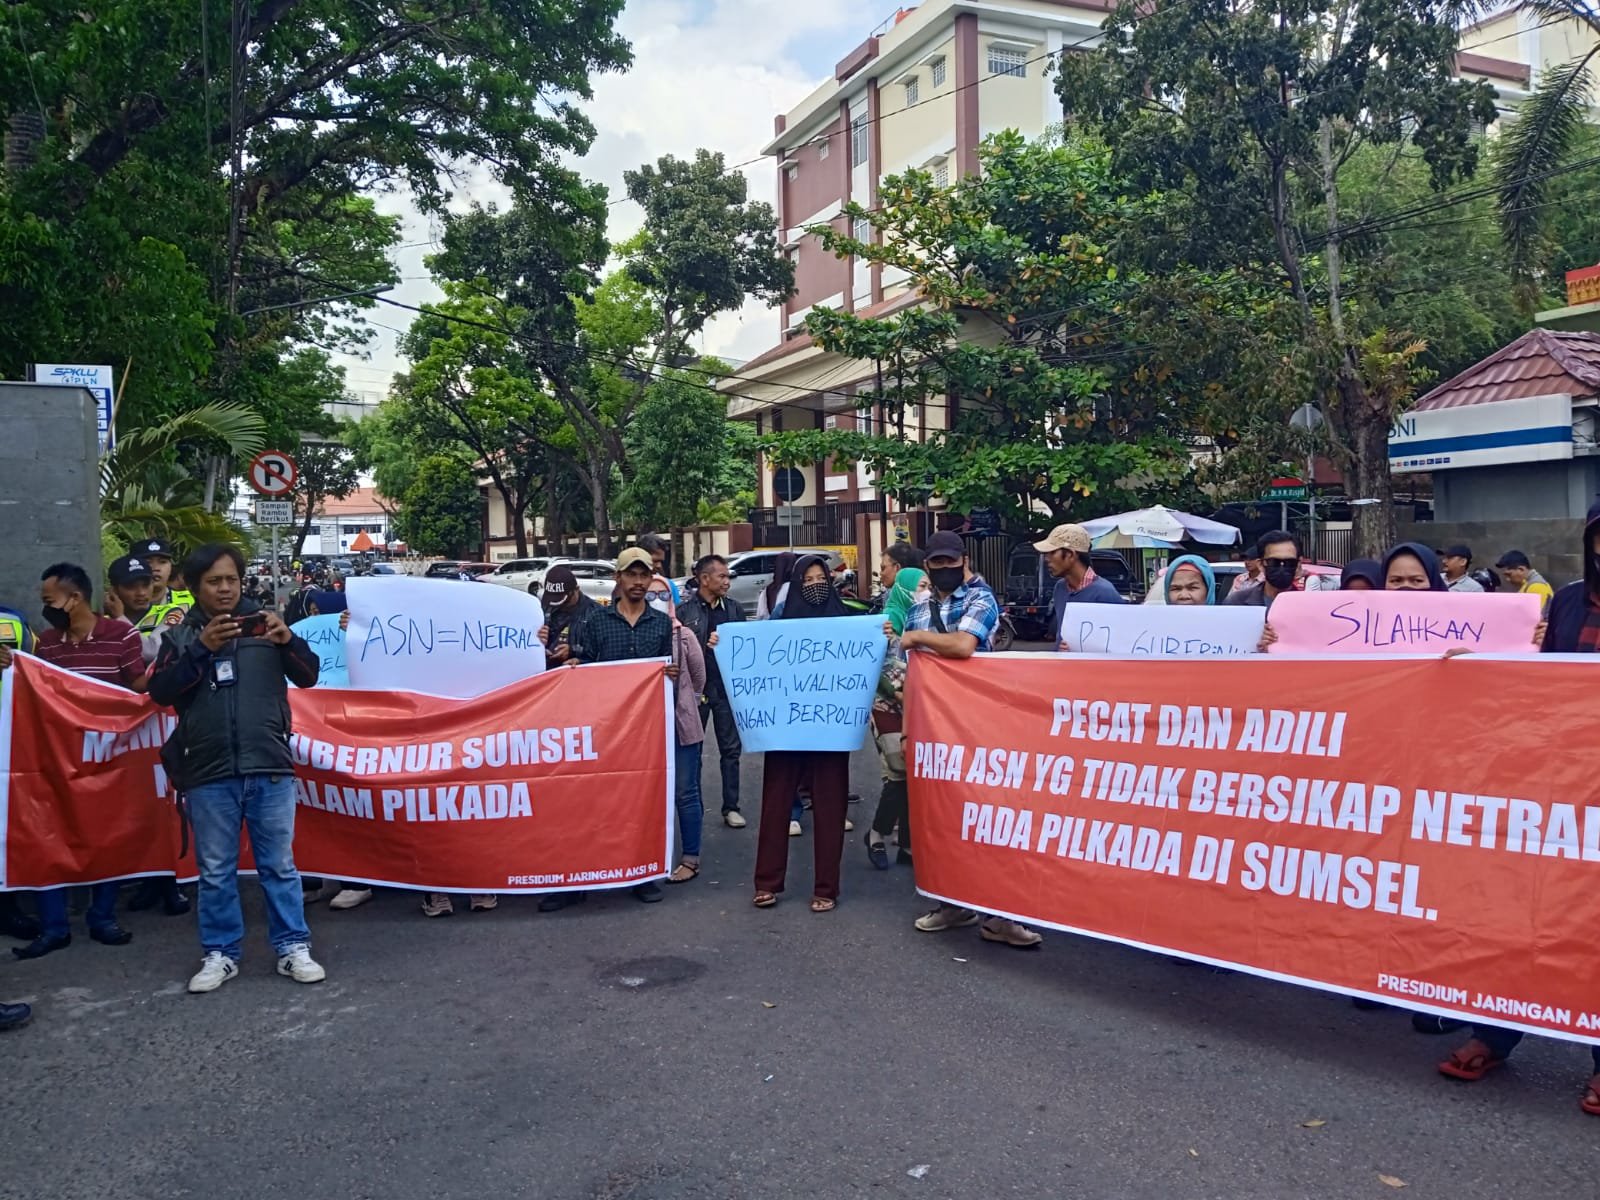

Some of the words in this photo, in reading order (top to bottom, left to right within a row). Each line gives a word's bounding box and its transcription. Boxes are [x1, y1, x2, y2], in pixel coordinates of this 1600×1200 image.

[50, 367, 98, 376] SPKLU
[74, 377, 97, 385] PLN
[260, 502, 289, 510] Sampai
[1327, 601, 1485, 647] SILAHKAN
[731, 635, 757, 672] PJ
[767, 634, 878, 666] GUBERNUR,
[731, 676, 788, 698] BUPATI,
[793, 673, 869, 693] WALIKOTA
[288, 732, 453, 776] UBERNUR
[462, 725, 599, 770] SUMSEL
[1050, 698, 1152, 744] PECAT
[1156, 704, 1232, 751] DAN
[1235, 708, 1347, 758] ADILI
[293, 777, 375, 820] ALAM
[381, 782, 533, 822] PILKADA
[913, 741, 965, 782] PARA
[965, 746, 1029, 790] ASN
[1032, 753, 1075, 796] YG
[1080, 758, 1187, 810] TIDAK
[1188, 769, 1402, 835] BERSIKAP
[507, 873, 565, 886] PRESIDIUM
[566, 868, 623, 883] JARINGAN
[625, 865, 647, 878] AKSI
[648, 862, 658, 872] 98
[961, 801, 1033, 851] PADA
[1036, 813, 1183, 877] PILKADA
[1188, 834, 1235, 885] DI
[1241, 841, 1438, 921] SUMSEL.
[1377, 973, 1468, 1006] PRESIDIUM
[1471, 992, 1571, 1026] JARINGAN
[1575, 1013, 1600, 1031] AK
